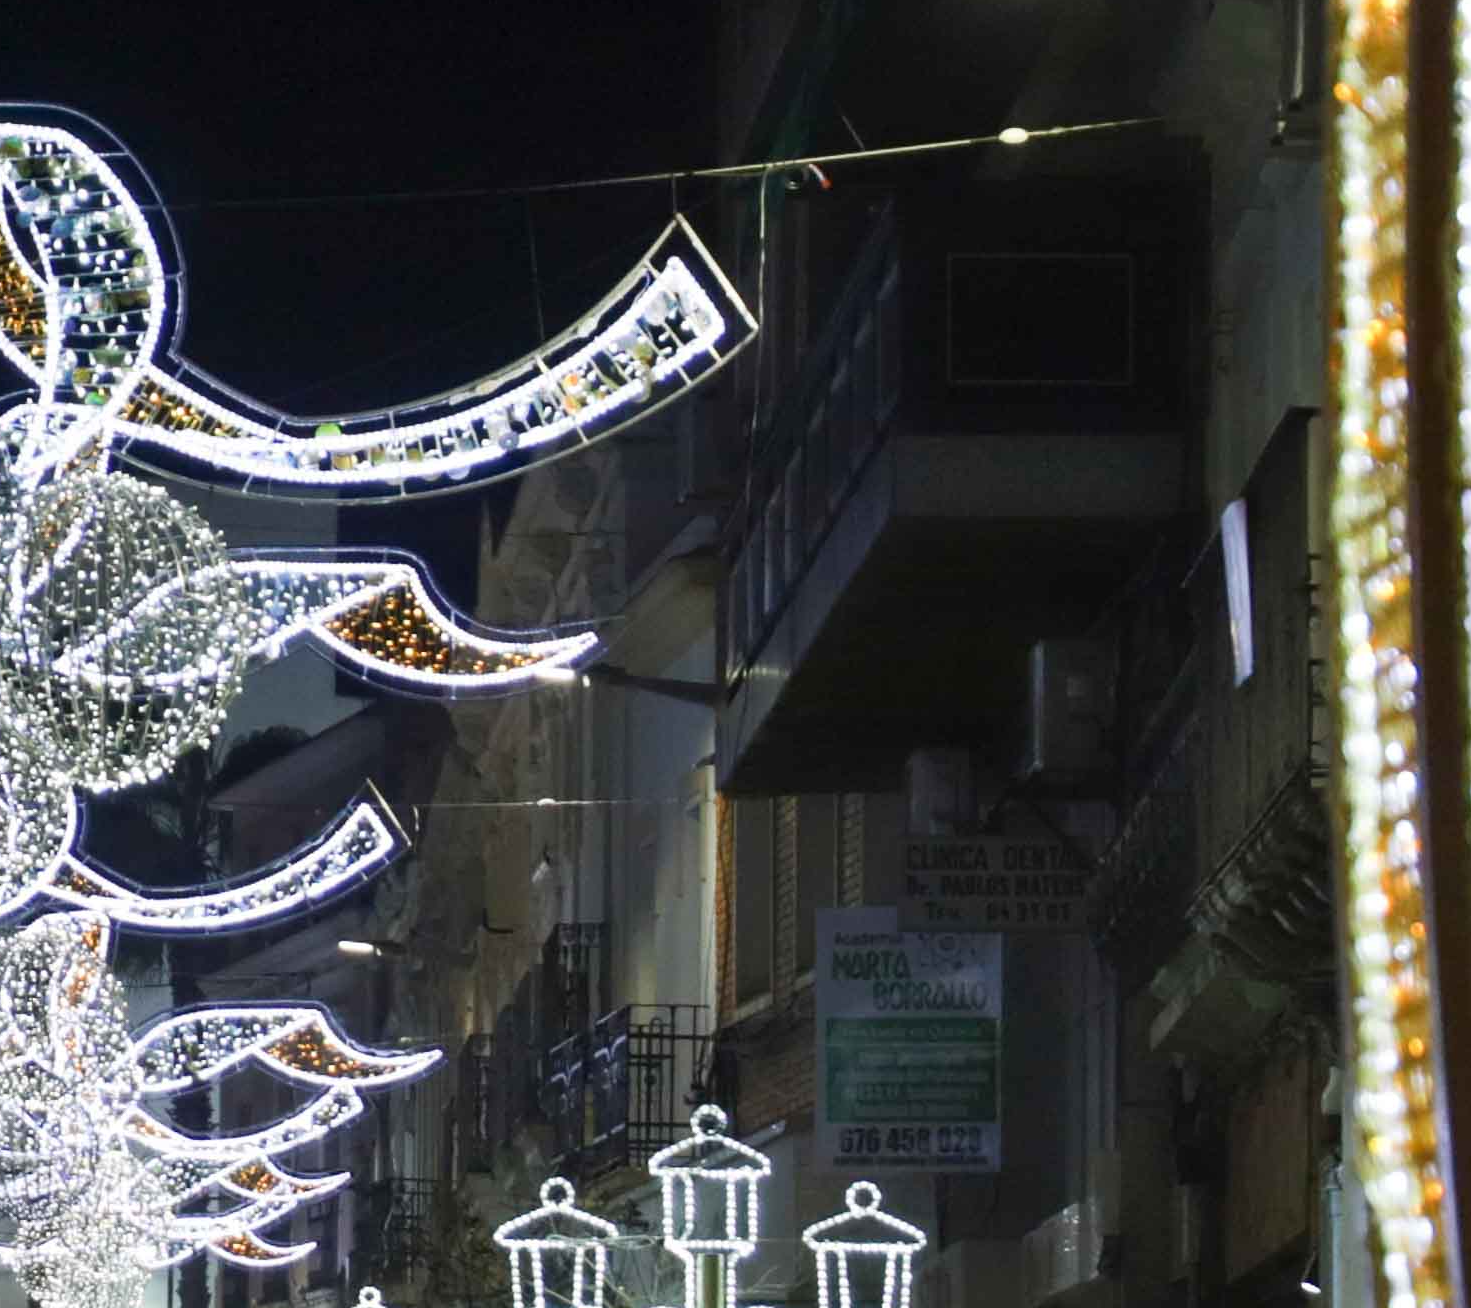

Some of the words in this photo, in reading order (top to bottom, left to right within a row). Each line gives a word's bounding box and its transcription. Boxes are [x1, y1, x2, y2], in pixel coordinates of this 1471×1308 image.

[832, 949, 912, 981] MARTA
[872, 979, 989, 1011] BORRALLO
[839, 1127, 881, 1153] 676
